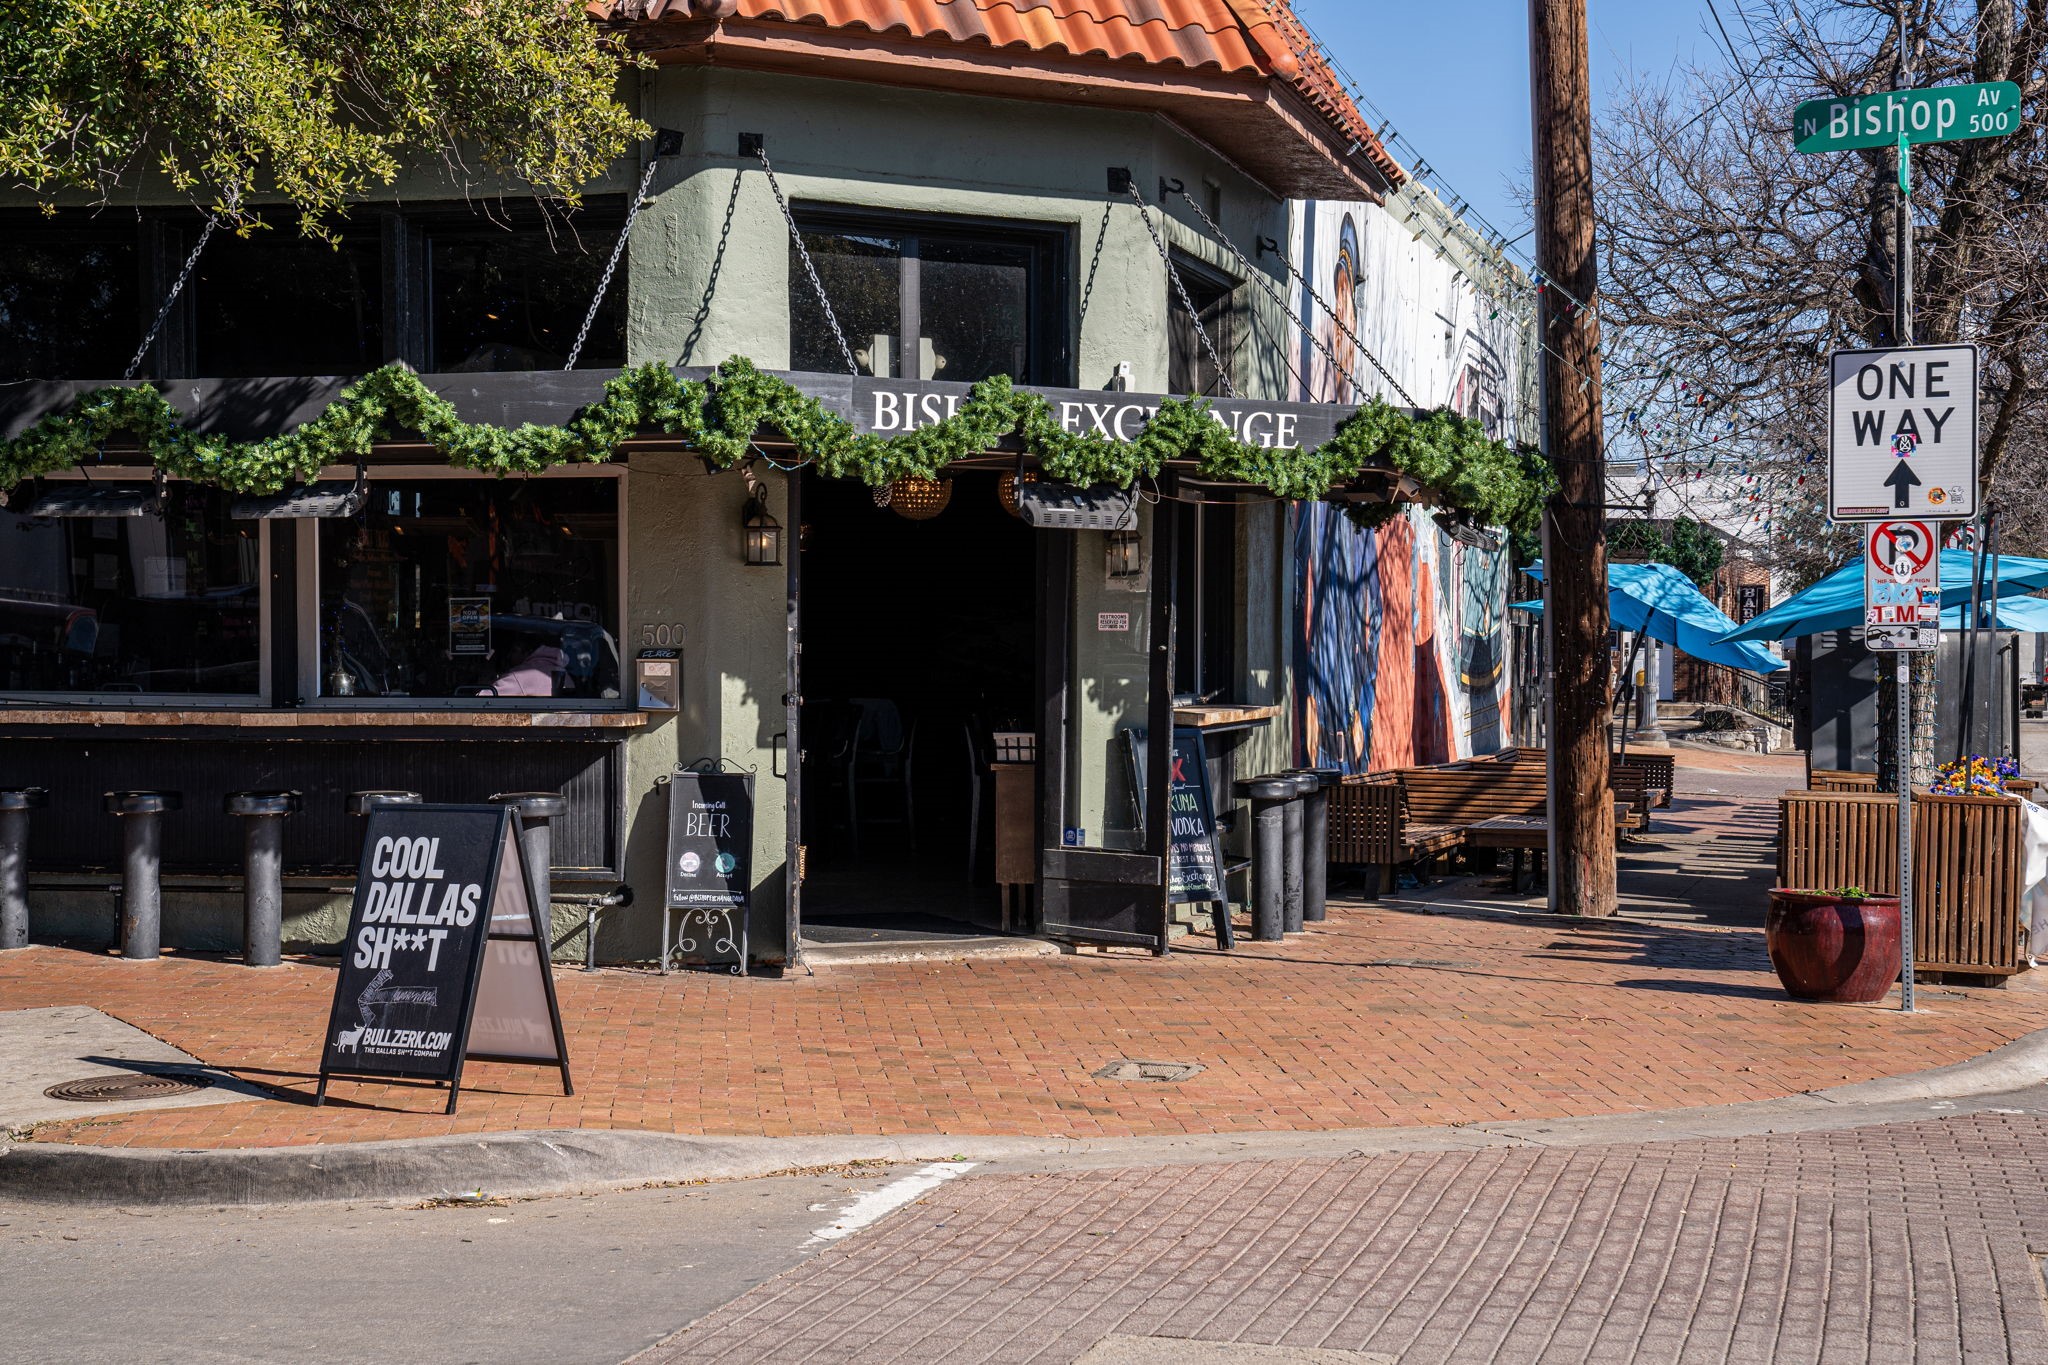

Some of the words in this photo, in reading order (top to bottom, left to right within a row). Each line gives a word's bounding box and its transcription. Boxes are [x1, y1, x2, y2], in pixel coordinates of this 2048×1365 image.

[1804, 118, 1817, 136] N
[1829, 95, 1956, 139] Bishop
[1977, 88, 2000, 107] Av
[1969, 112, 2008, 134] 500
[1857, 361, 1950, 401] ONE
[871, 391, 960, 432] BIS
[1059, 402, 1300, 450] EXCNGE
[1852, 407, 1956, 447] WAY
[641, 624, 687, 647] 500
[715, 801, 725, 809] Call
[686, 812, 731, 838] BEER
[371, 836, 445, 880] COOL
[361, 881, 482, 927] DALLAS
[362, 1027, 452, 1050] BULLZERK.COM
[375, 1047, 396, 1055] DALLAS
[413, 1049, 441, 1057] COMPANY
